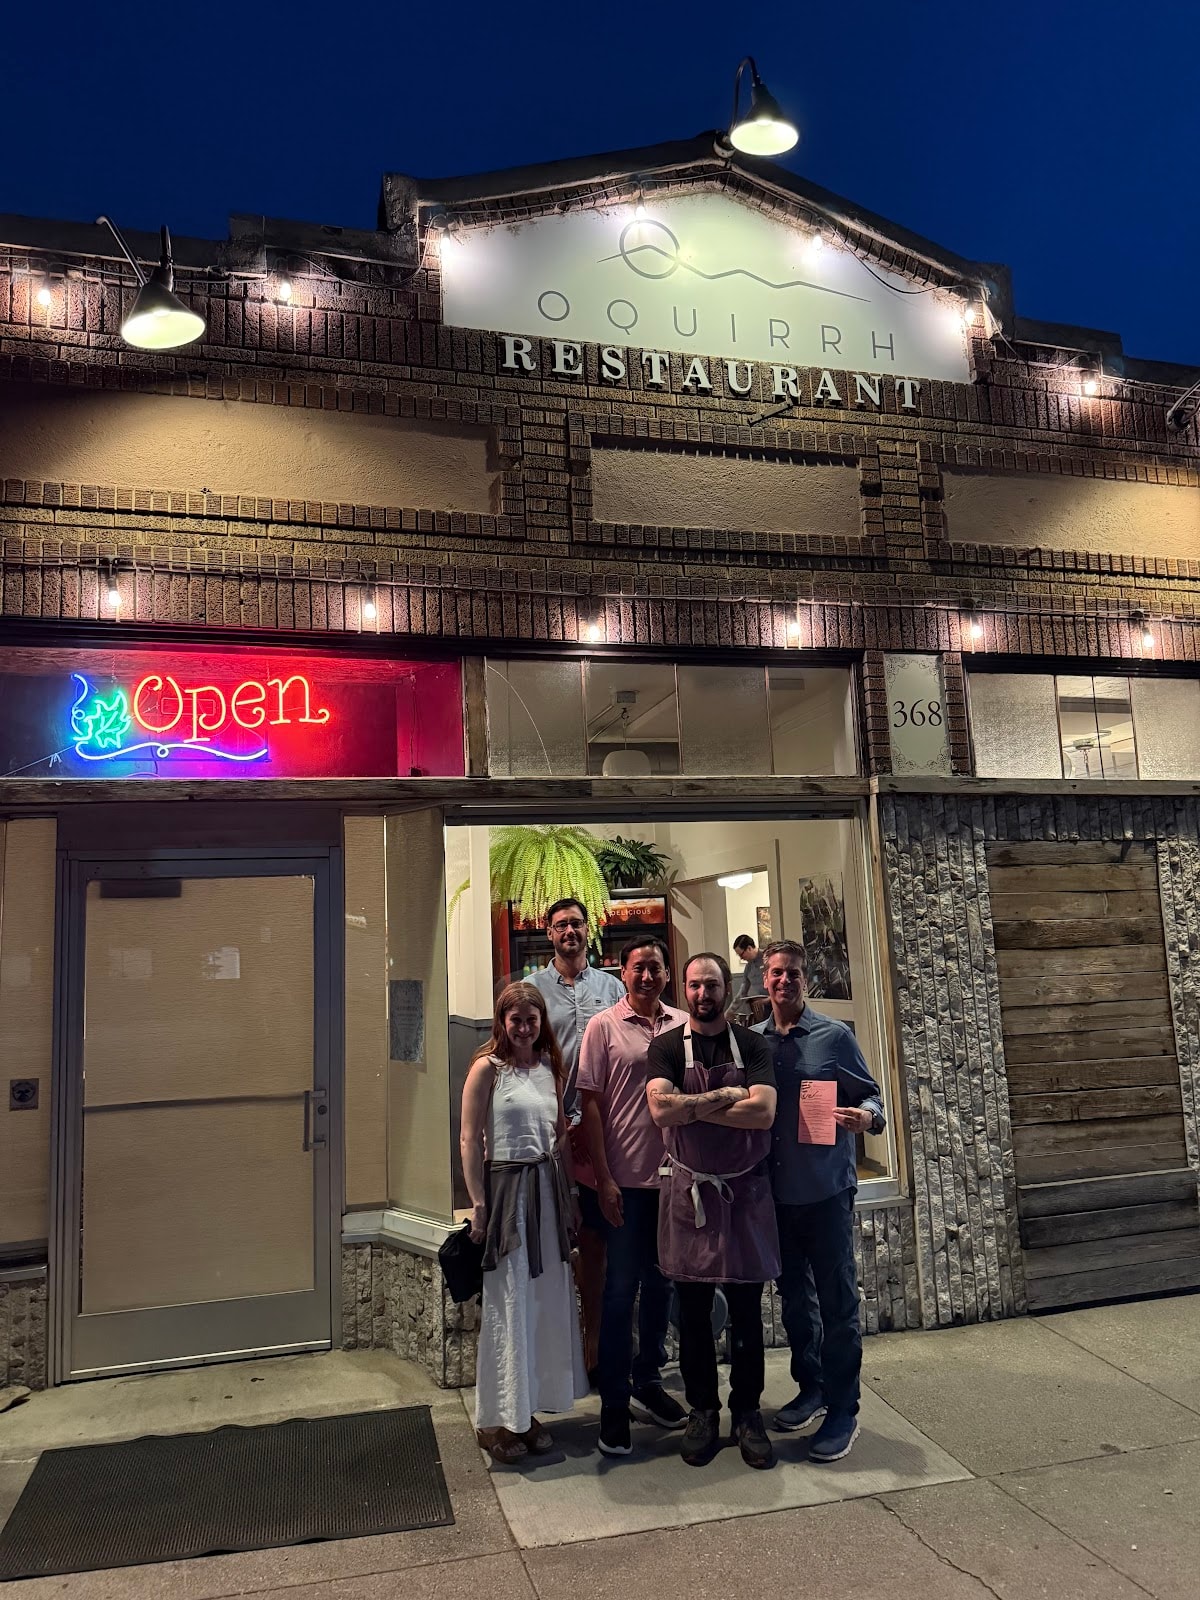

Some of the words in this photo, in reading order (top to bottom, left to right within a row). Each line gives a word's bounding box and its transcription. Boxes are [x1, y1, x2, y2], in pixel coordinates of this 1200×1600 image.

[537, 290, 896, 362] OQUIRRH
[501, 335, 921, 409] RESTAURANT
[133, 674, 330, 743] Open
[893, 699, 942, 727] 368
